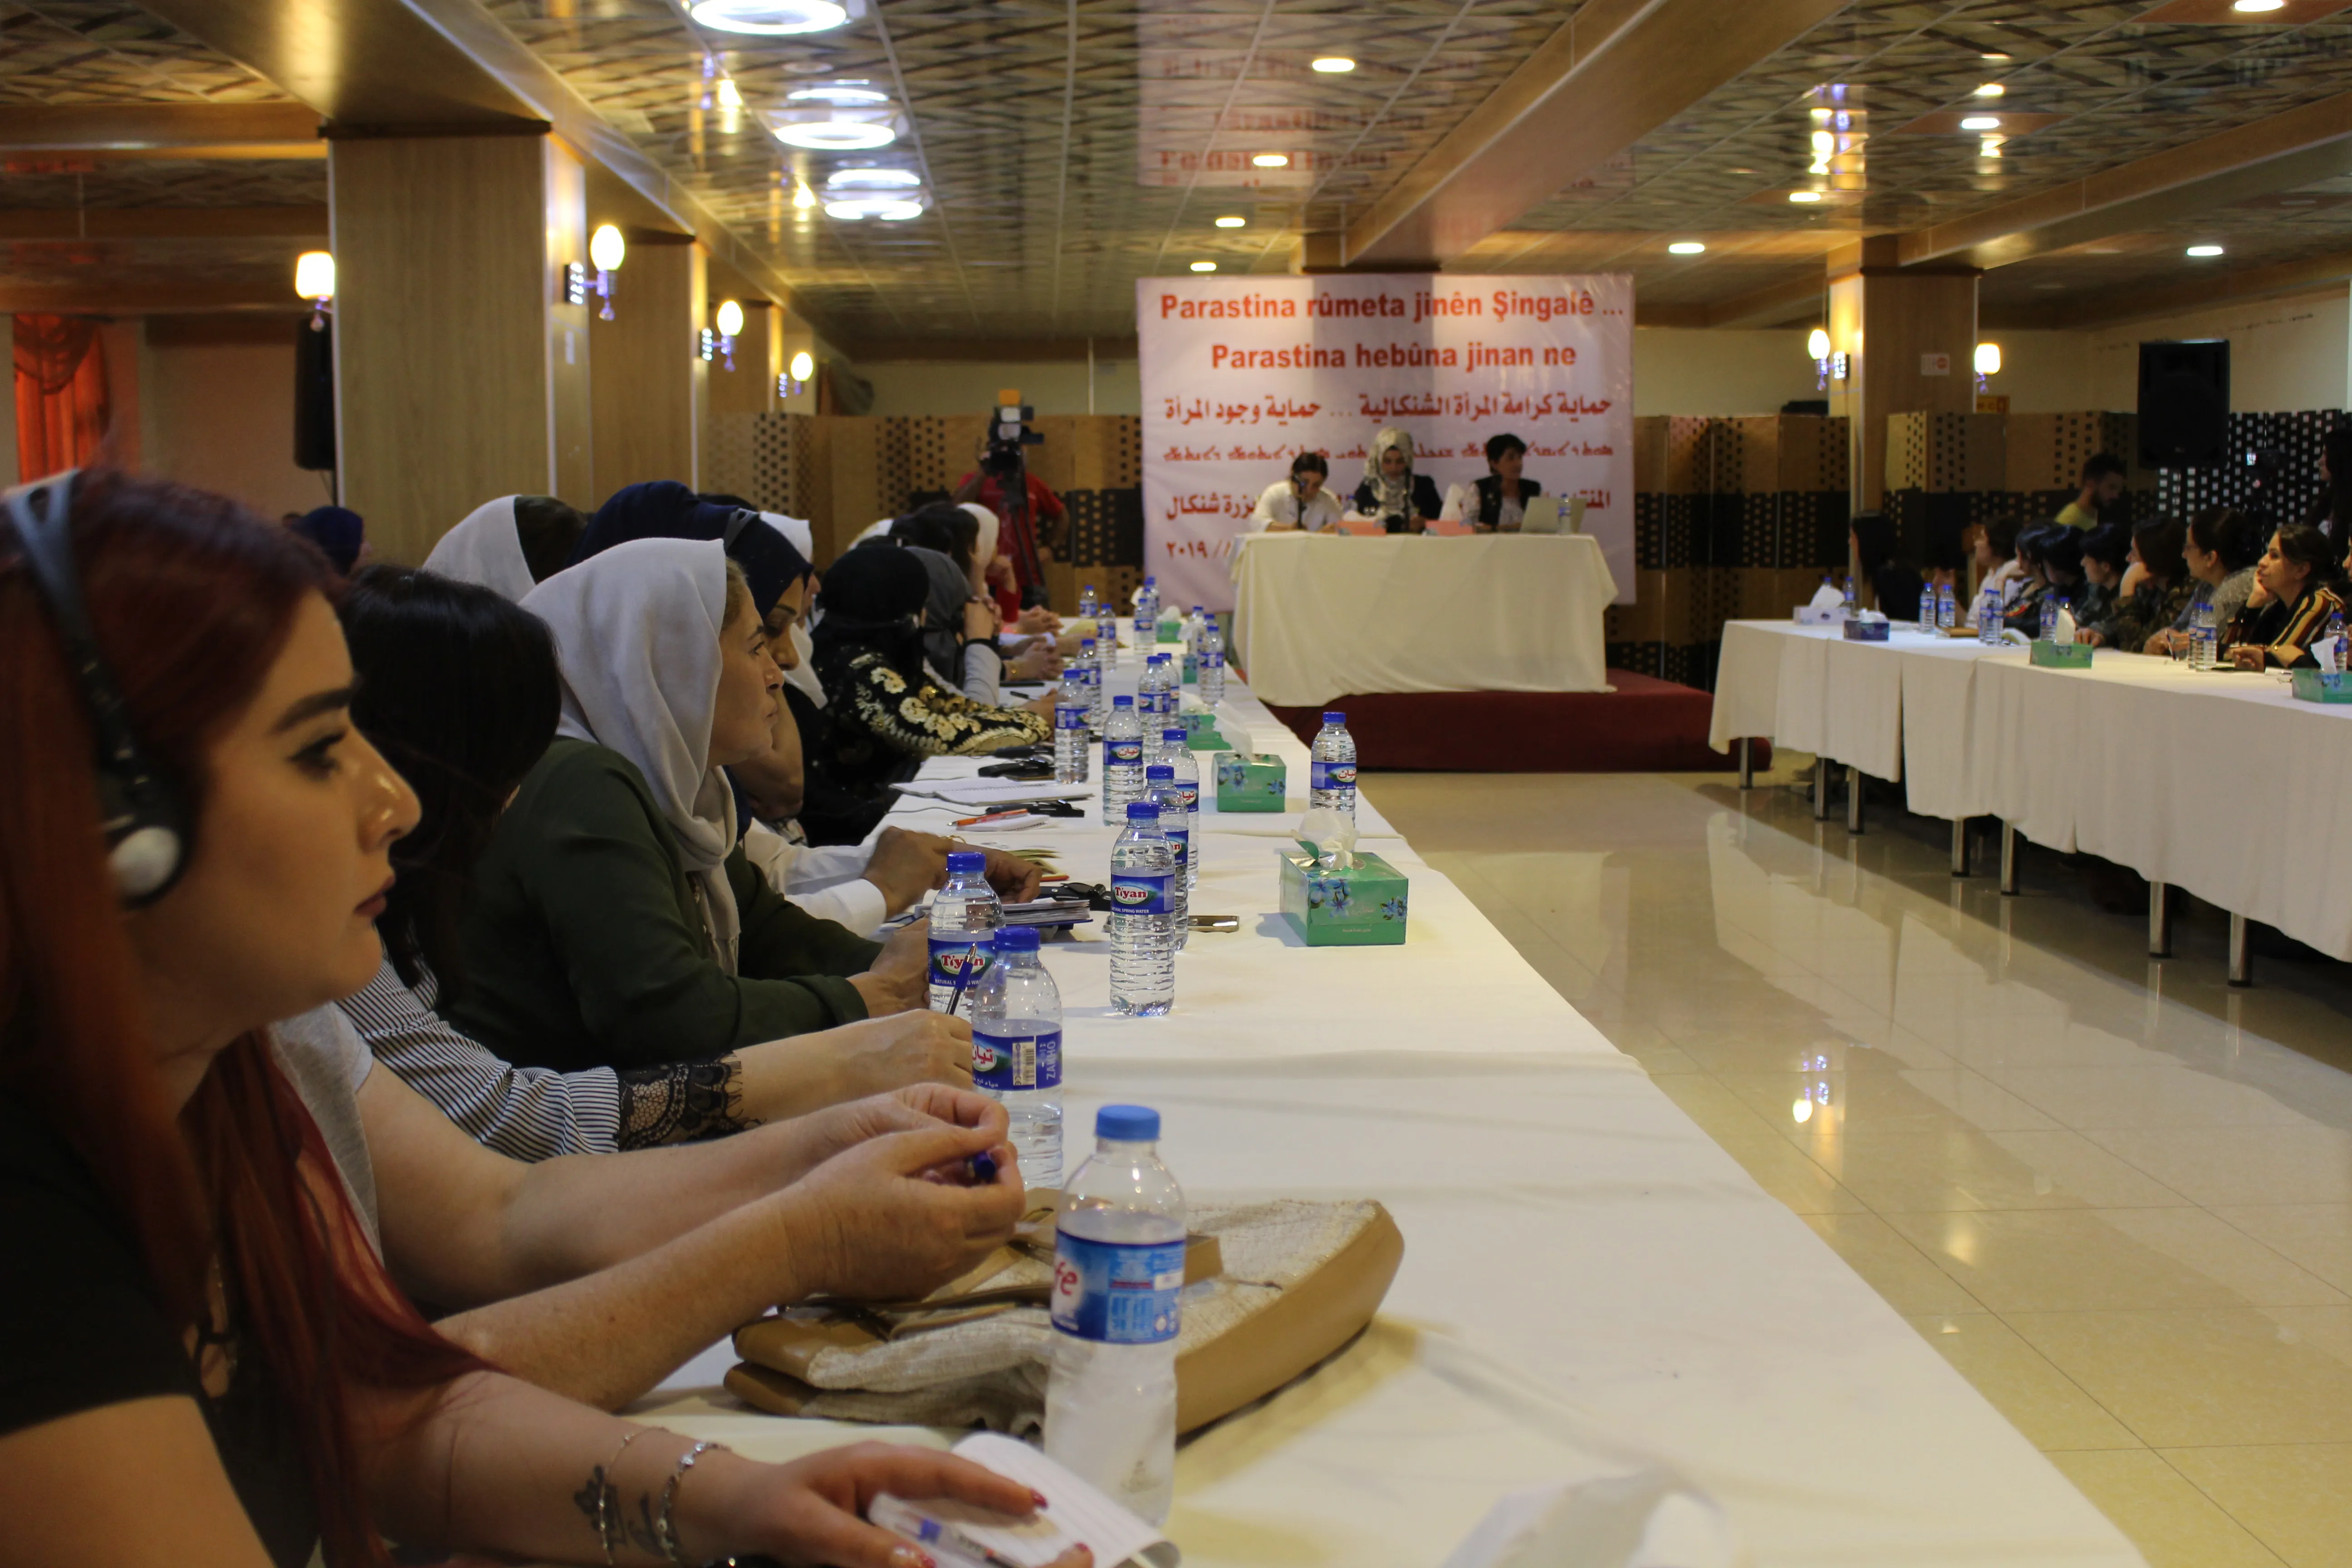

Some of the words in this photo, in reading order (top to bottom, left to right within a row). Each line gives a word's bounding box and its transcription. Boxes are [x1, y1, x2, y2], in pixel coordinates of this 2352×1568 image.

[1160, 293, 1295, 318] Parastina
[1307, 292, 1404, 318] rûmeta
[1413, 291, 1482, 323] jinên
[1492, 291, 1594, 323] Şingalê
[1212, 343, 1346, 369] Parastina
[1356, 343, 1458, 368] hebûna
[1466, 342, 1533, 373] jinan
[1544, 346, 1576, 366] ne
[1164, 396, 1210, 426] المرأة
[1215, 399, 1260, 425] وجود
[1264, 395, 1322, 426] حماية
[1359, 392, 1450, 424] الشنكالية
[1454, 392, 1497, 422] المرأة
[1502, 393, 1553, 421] كرامة
[1557, 391, 1612, 422] حماية
[1166, 492, 1220, 520] شنكال
[1114, 887, 1147, 899] Tiyan
[941, 954, 985, 970] Tiyn
